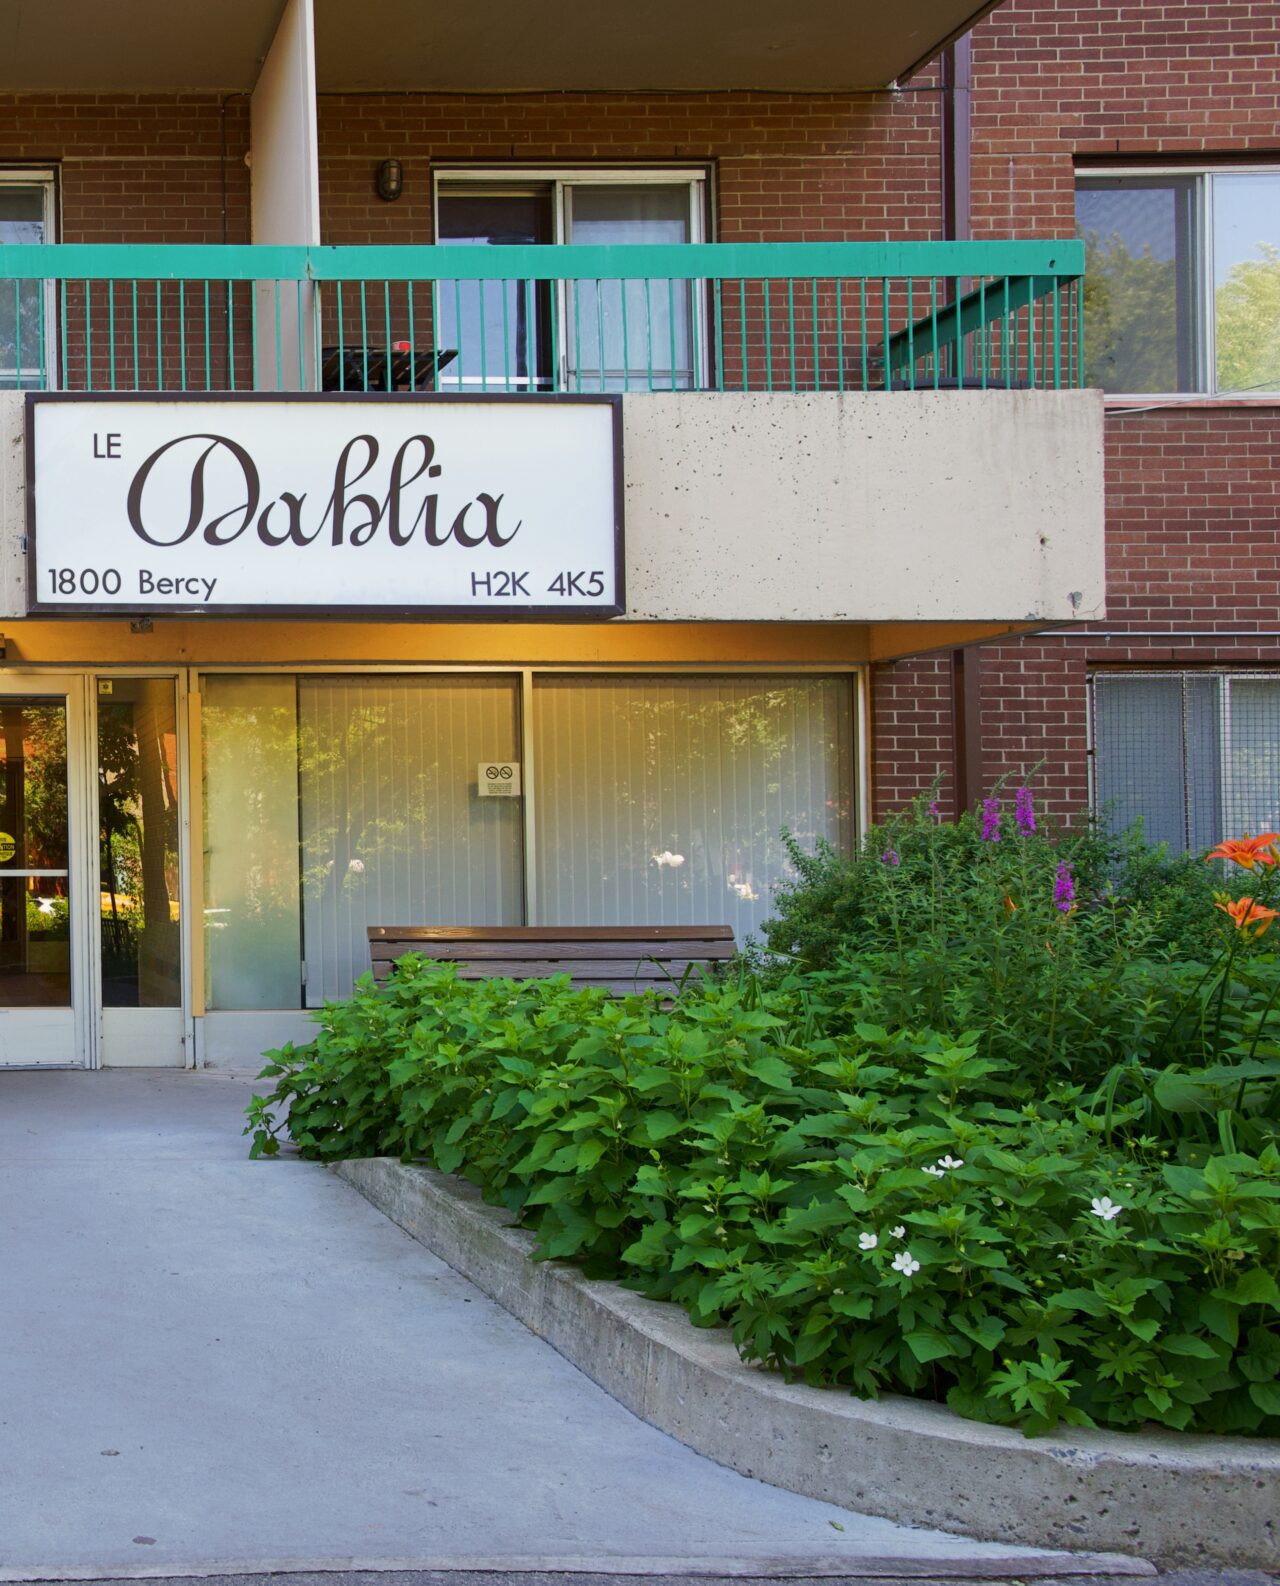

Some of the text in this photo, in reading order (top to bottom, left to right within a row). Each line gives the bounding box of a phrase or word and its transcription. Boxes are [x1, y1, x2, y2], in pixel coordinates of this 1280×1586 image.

[93, 433, 522, 548] LE Dahlia
[48, 568, 217, 602] 1800 Bercy
[471, 570, 605, 597] H2K 4K5
